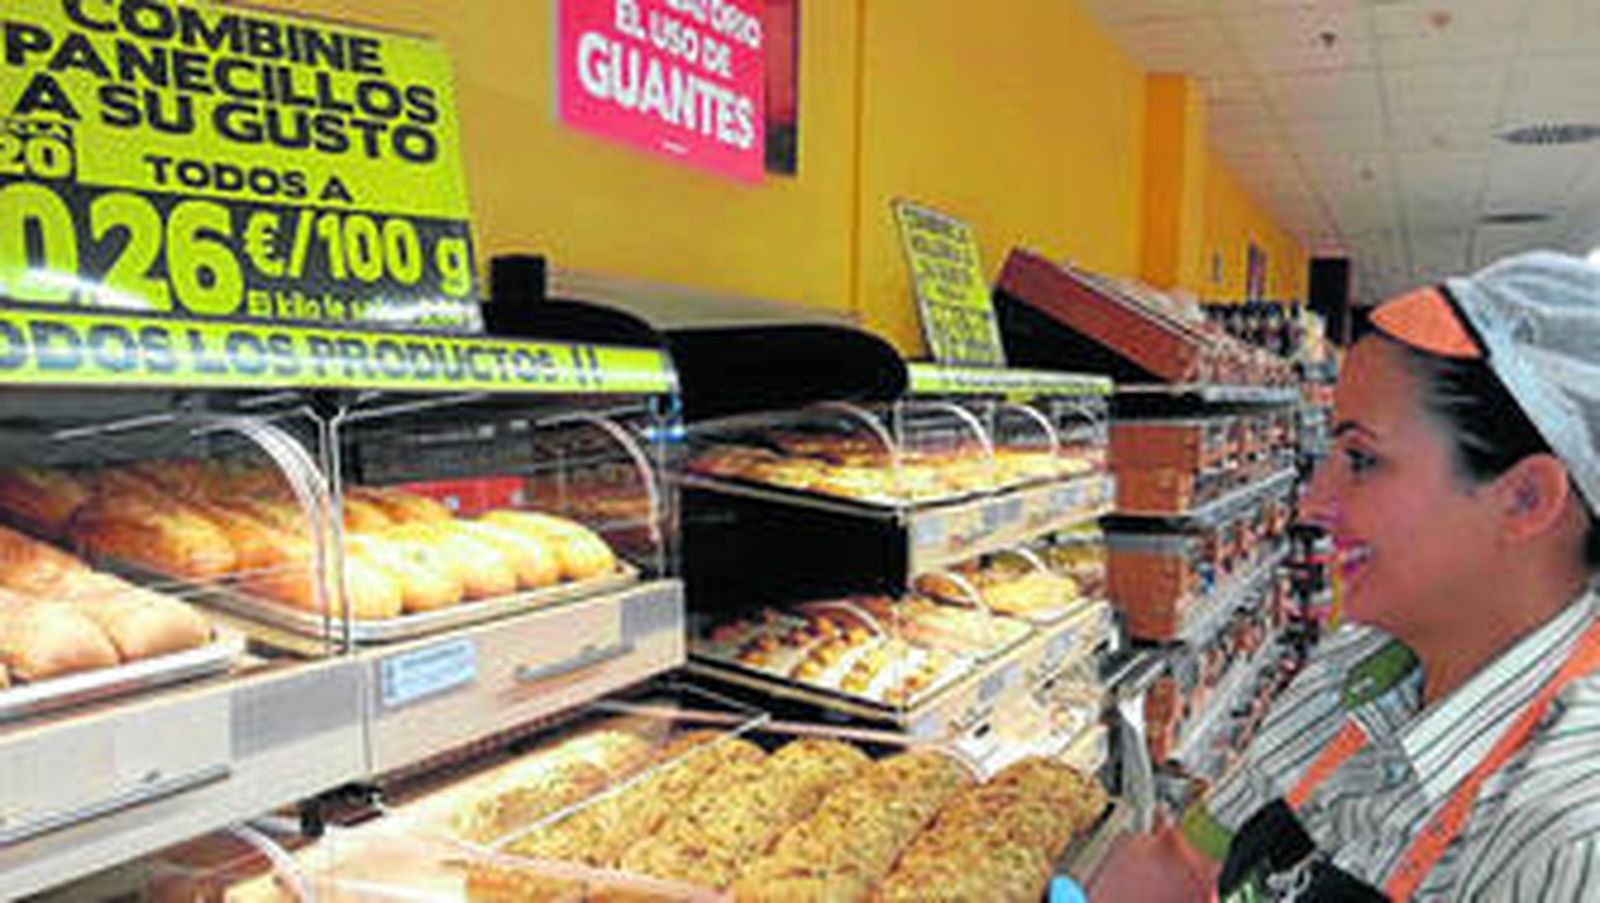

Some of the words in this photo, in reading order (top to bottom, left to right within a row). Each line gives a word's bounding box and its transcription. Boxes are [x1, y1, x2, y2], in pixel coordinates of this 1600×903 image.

[3, 22, 437, 124] PANECILLOS
[62, 0, 384, 75] COMBINE
[649, 10, 698, 64] USO
[702, 35, 733, 79] DE
[13, 73, 81, 121] A
[97, 84, 195, 134] SU
[213, 101, 437, 163] GUSTO
[577, 31, 754, 149] GUANTES
[143, 154, 308, 198] TODOS
[318, 176, 354, 203] A
[187, 329, 300, 377] LOS
[306, 334, 557, 383] PRODUCTOS
